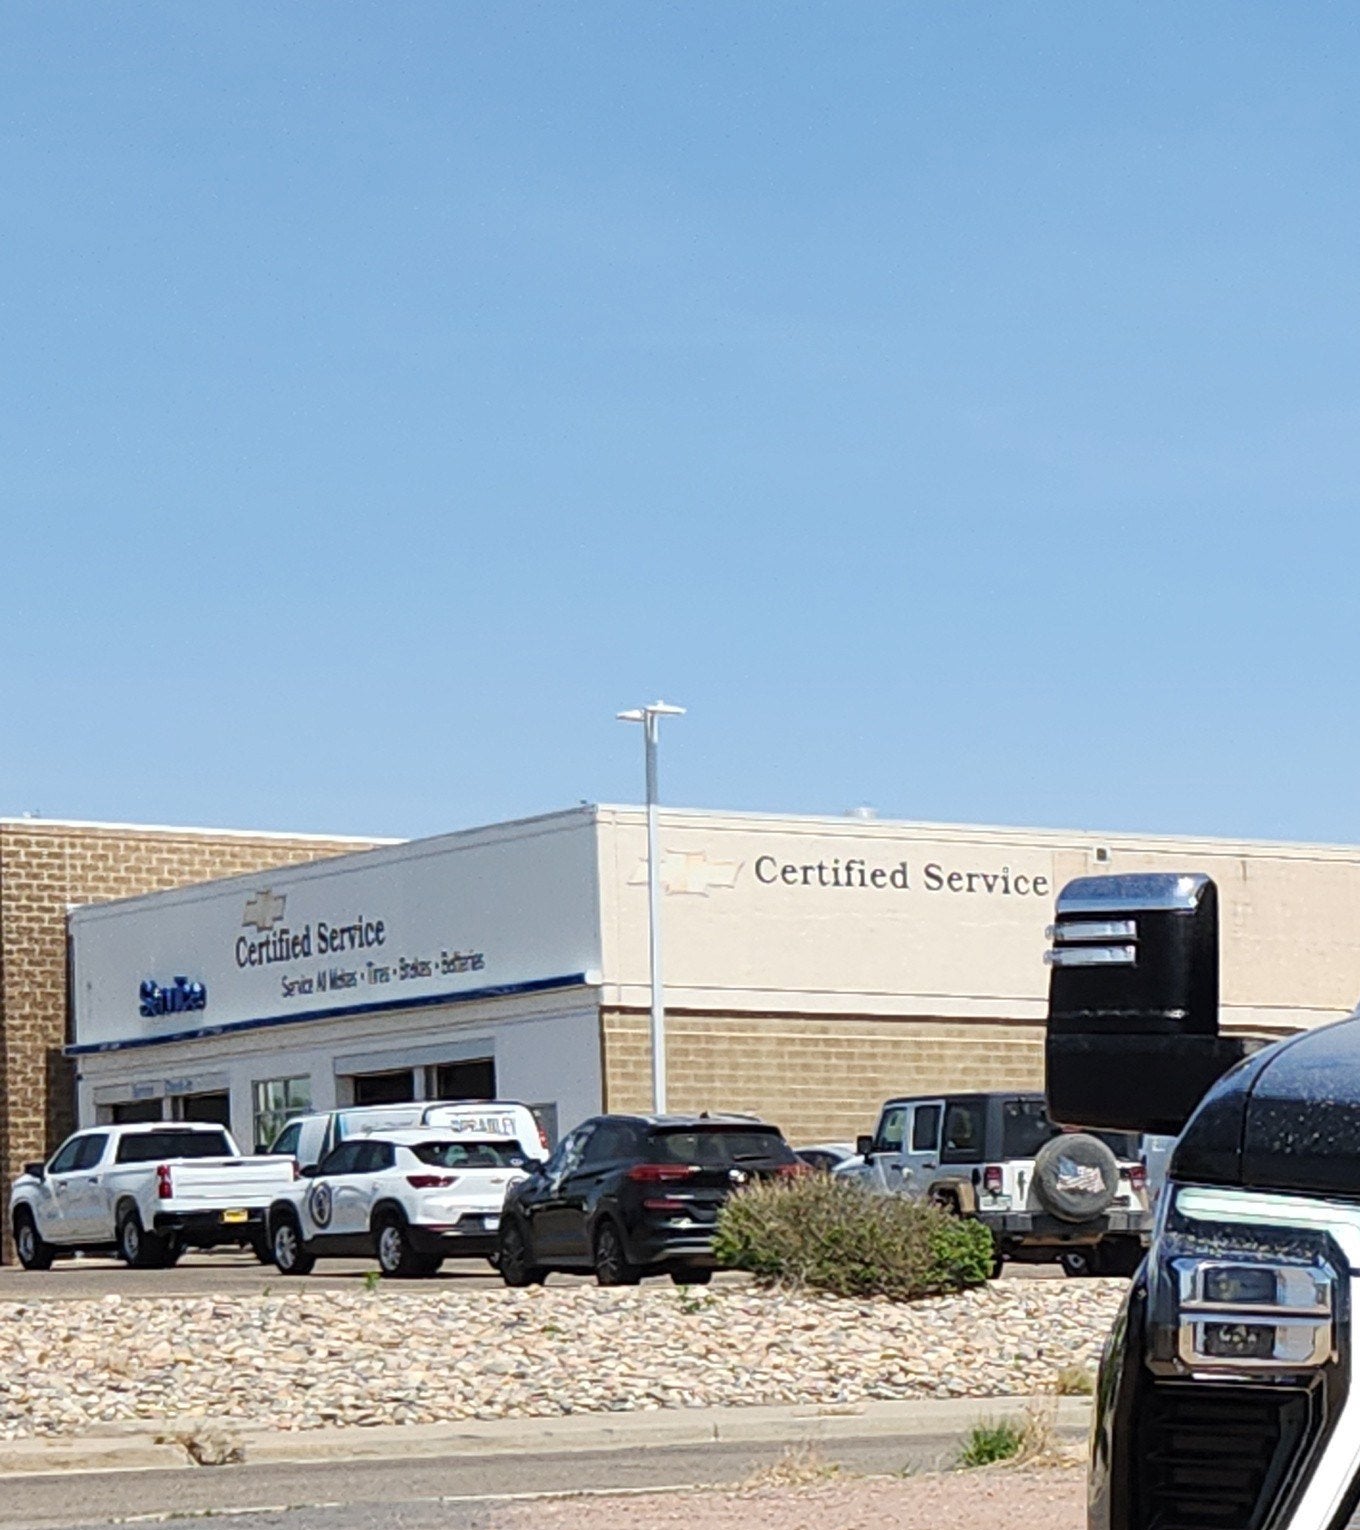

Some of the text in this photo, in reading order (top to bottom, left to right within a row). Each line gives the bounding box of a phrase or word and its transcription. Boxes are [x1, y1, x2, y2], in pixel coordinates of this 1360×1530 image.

[755, 855, 1049, 896] Certified Service
[235, 914, 386, 968] Certified Service
